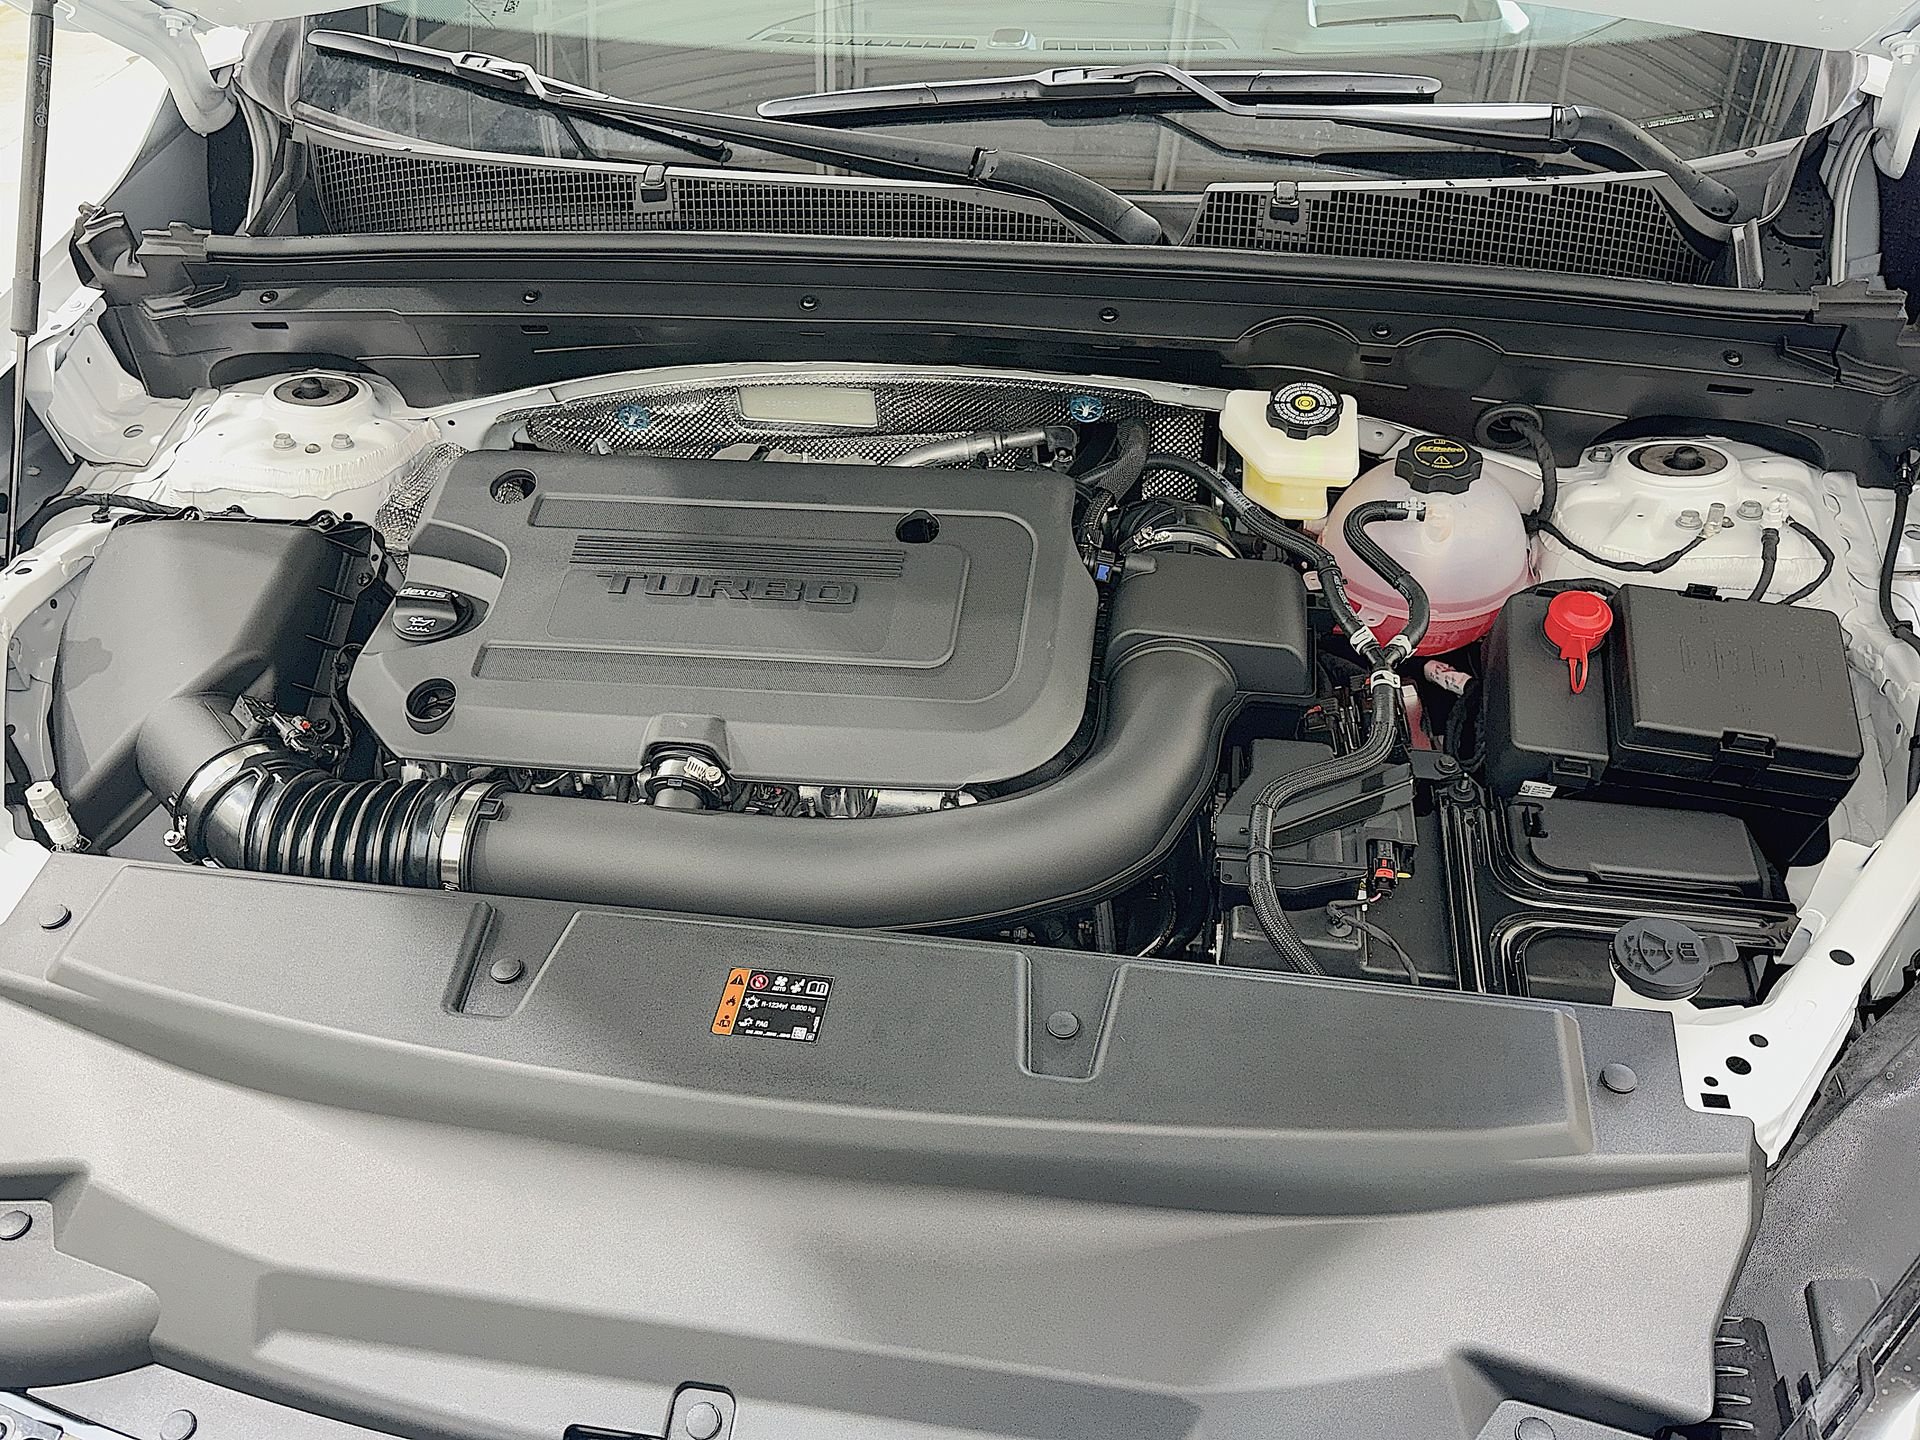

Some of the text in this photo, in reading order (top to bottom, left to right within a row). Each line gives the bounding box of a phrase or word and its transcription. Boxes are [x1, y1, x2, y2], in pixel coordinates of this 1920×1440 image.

[1417, 445, 1464, 453] ACDelco
[400, 587, 447, 598] dexos
[596, 573, 858, 605] TURBO
[807, 1005, 816, 1013] kg
[755, 1020, 769, 1028] PAG
